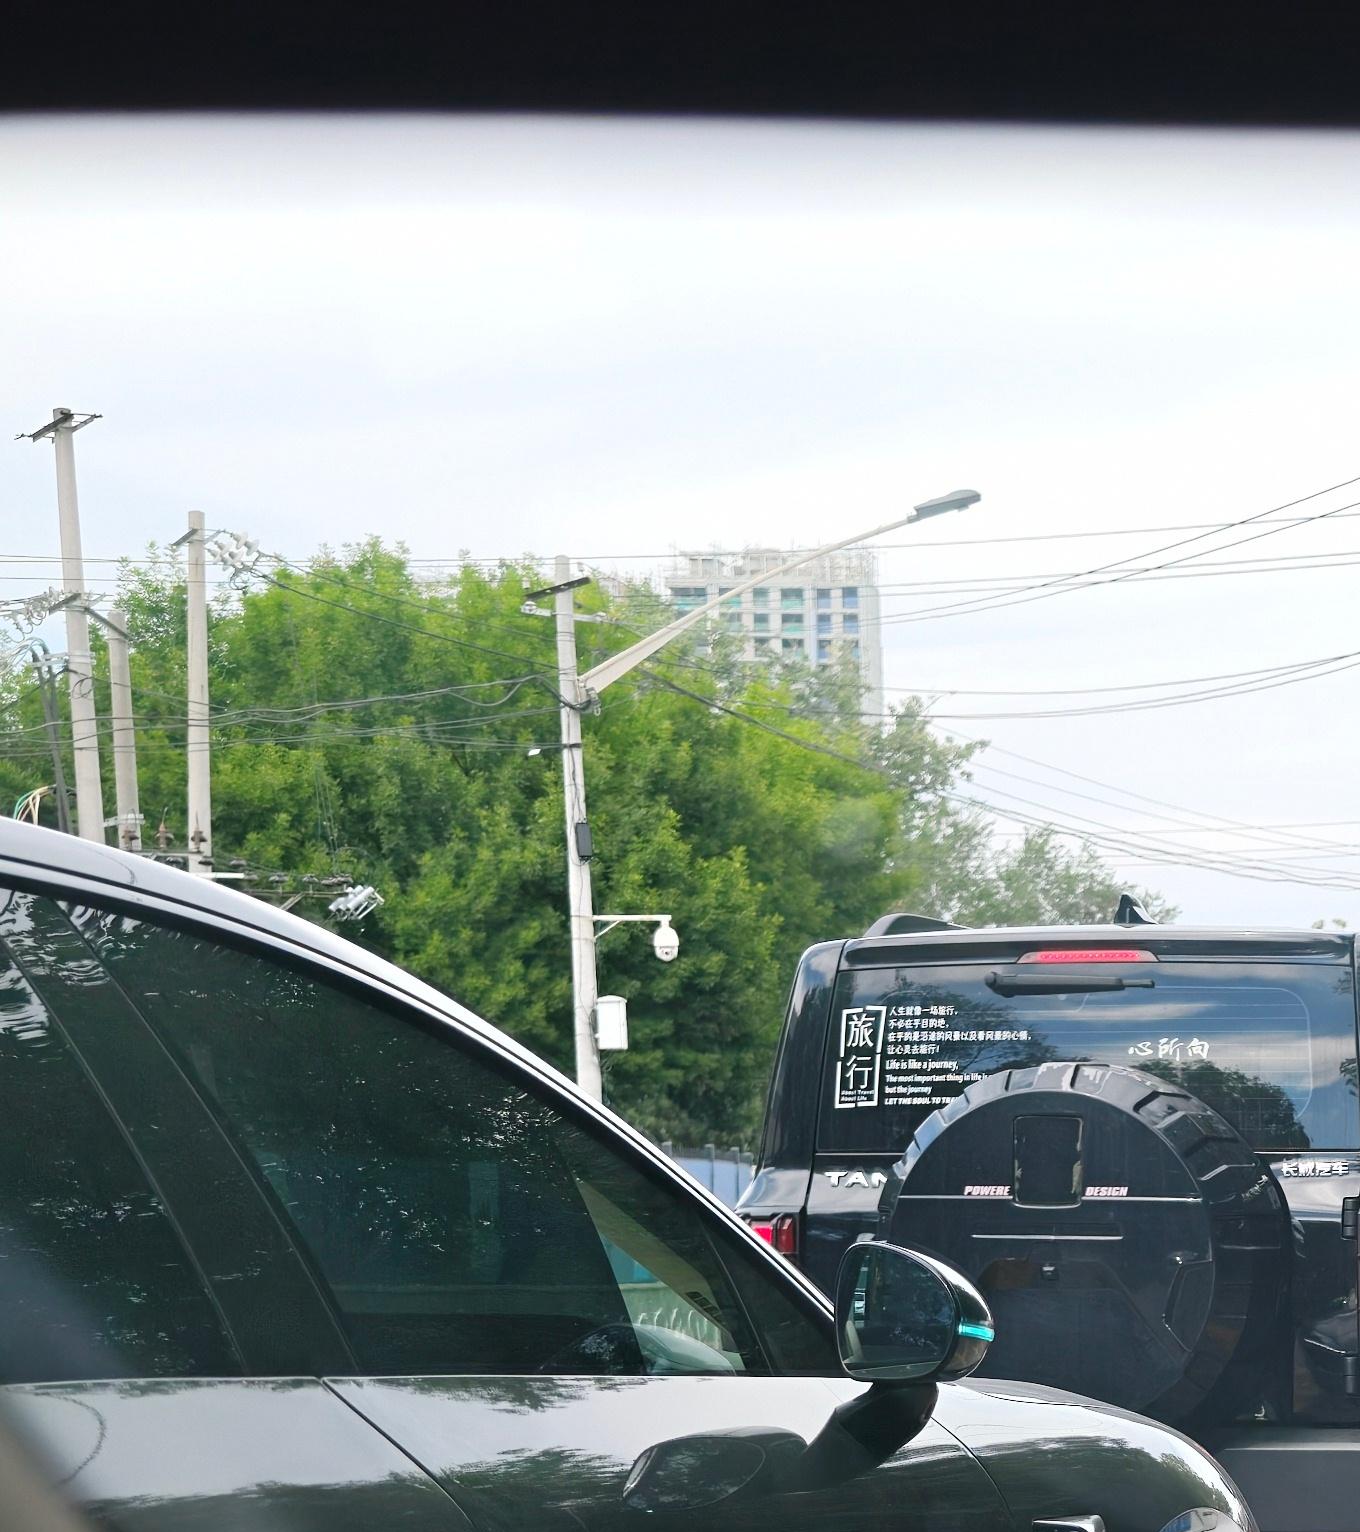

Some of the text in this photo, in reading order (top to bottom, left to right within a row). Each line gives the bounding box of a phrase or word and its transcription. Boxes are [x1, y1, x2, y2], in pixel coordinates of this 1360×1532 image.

[845, 1013, 876, 1090] 旅行
[1128, 1037, 1210, 1061] 心所向
[885, 1059, 958, 1071] Life is like a journey,
[886, 1074, 898, 1082] The
[914, 1074, 946, 1083] important
[946, 1073, 964, 1083] thing
[907, 1085, 932, 1095] journey
[884, 1097, 898, 1105] LET
[898, 1097, 912, 1105] THE
[912, 1097, 931, 1105] SOUL
[1281, 1161, 1349, 1177] 长城汽车
[824, 1171, 889, 1187] TAN
[1085, 1186, 1129, 1197] DESIGN
